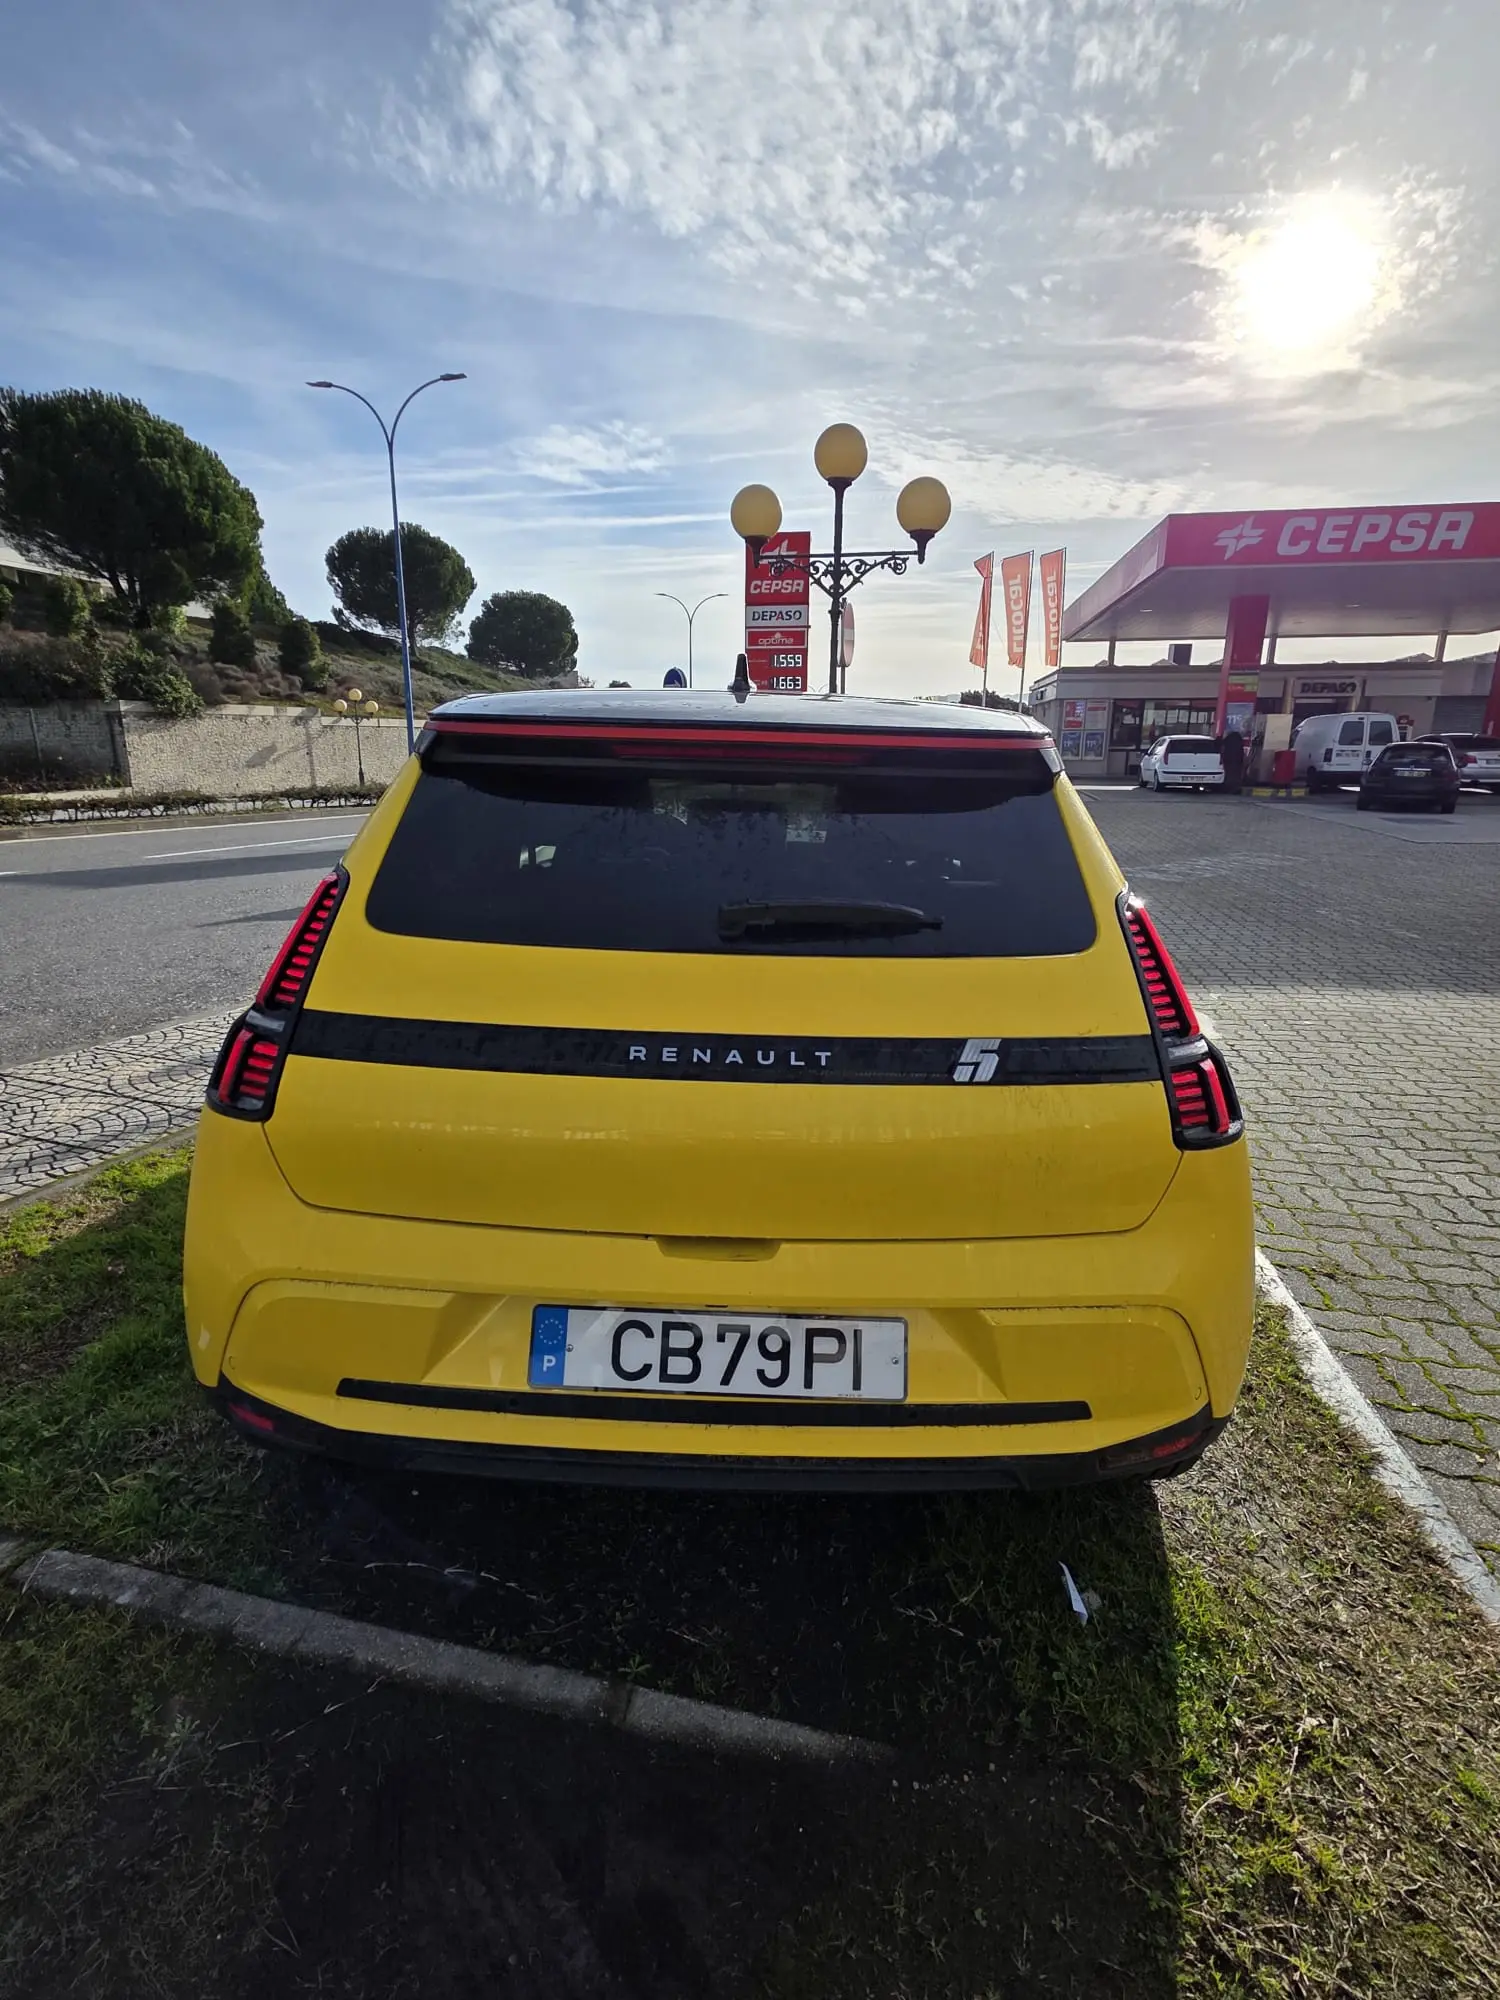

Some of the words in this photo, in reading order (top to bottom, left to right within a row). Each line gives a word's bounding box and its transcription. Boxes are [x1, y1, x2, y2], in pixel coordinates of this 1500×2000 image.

[1276, 510, 1475, 556] CEPSA
[750, 579, 804, 594] CEPSA
[752, 609, 802, 621] DEPASO
[758, 637, 794, 646] optima
[1300, 682, 1357, 694] DEPASO
[629, 1045, 832, 1066] RENAULT
[543, 1355, 556, 1373] P
